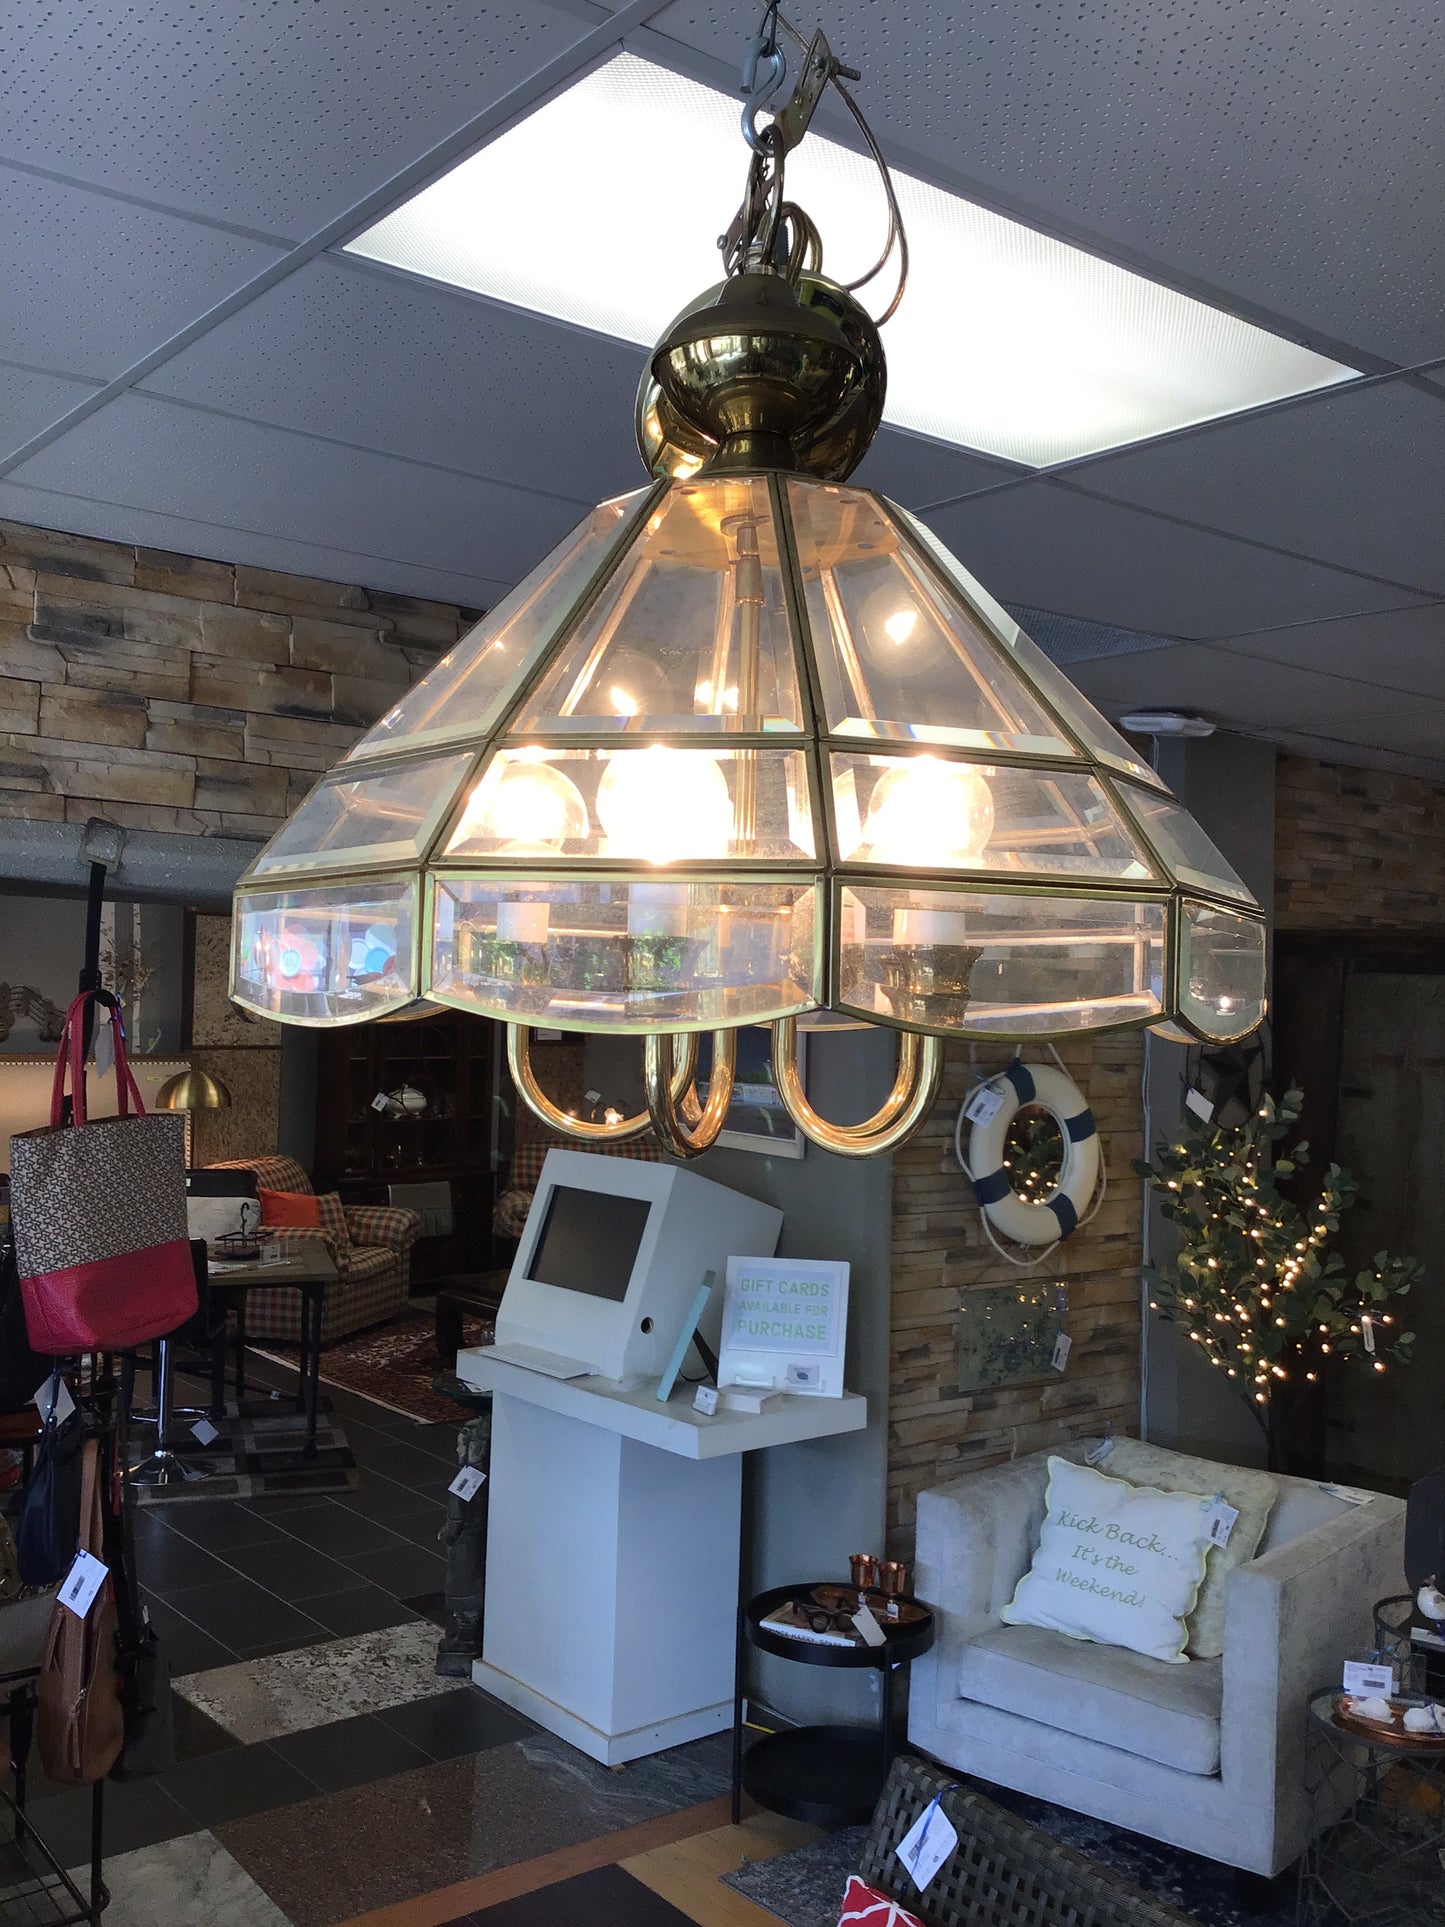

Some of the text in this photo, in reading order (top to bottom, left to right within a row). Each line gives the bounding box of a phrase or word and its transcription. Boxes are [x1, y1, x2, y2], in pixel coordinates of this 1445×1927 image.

[741, 1279, 830, 1297] GIFT CARDS
[739, 1300, 829, 1317] AVAILABLE FOR
[736, 1320, 827, 1340] PURCHASE
[1056, 1511, 1102, 1534] Kick
[1105, 1523, 1179, 1561] Back...
[1071, 1545, 1139, 1576] It's the
[1056, 1568, 1146, 1608] Weekend!
